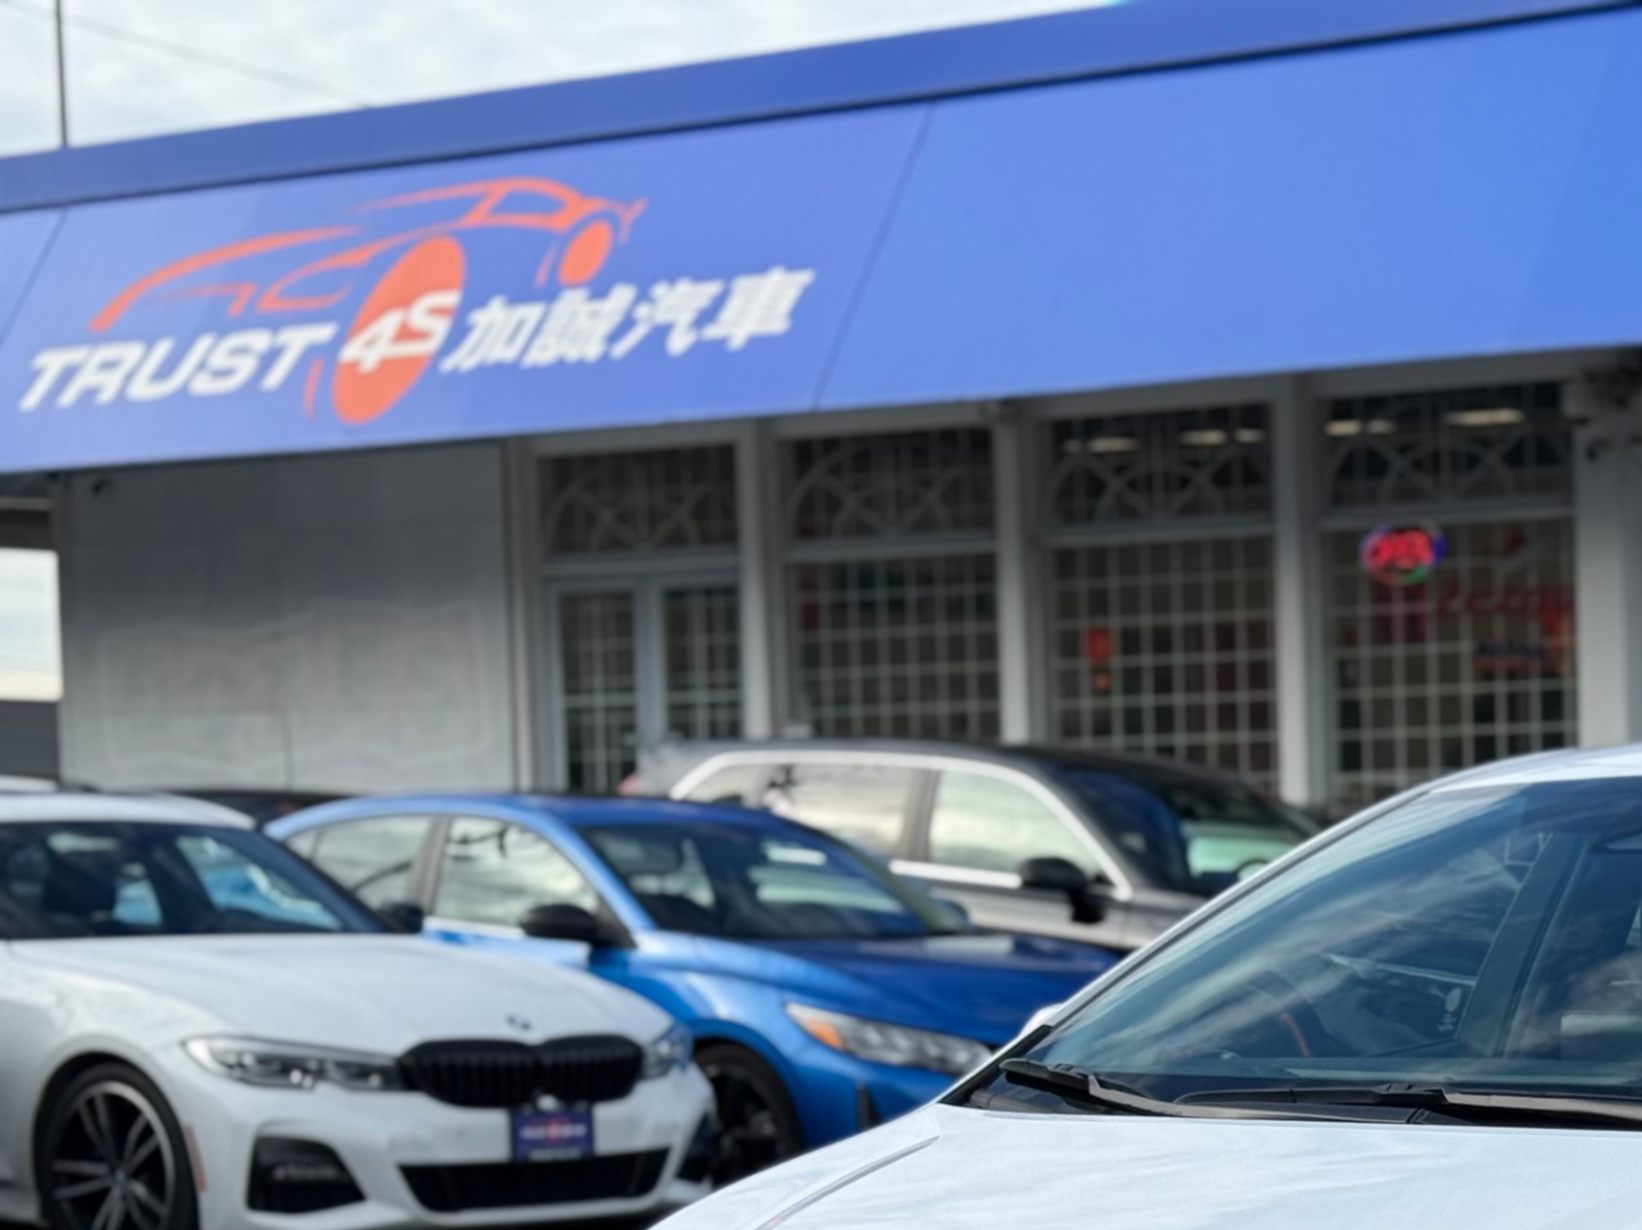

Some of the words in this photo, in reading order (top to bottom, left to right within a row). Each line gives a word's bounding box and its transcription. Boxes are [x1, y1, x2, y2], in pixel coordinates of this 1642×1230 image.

[18, 322, 338, 412] TRUST
[339, 289, 461, 373] 4S
[438, 265, 815, 375] 加誠汽車
